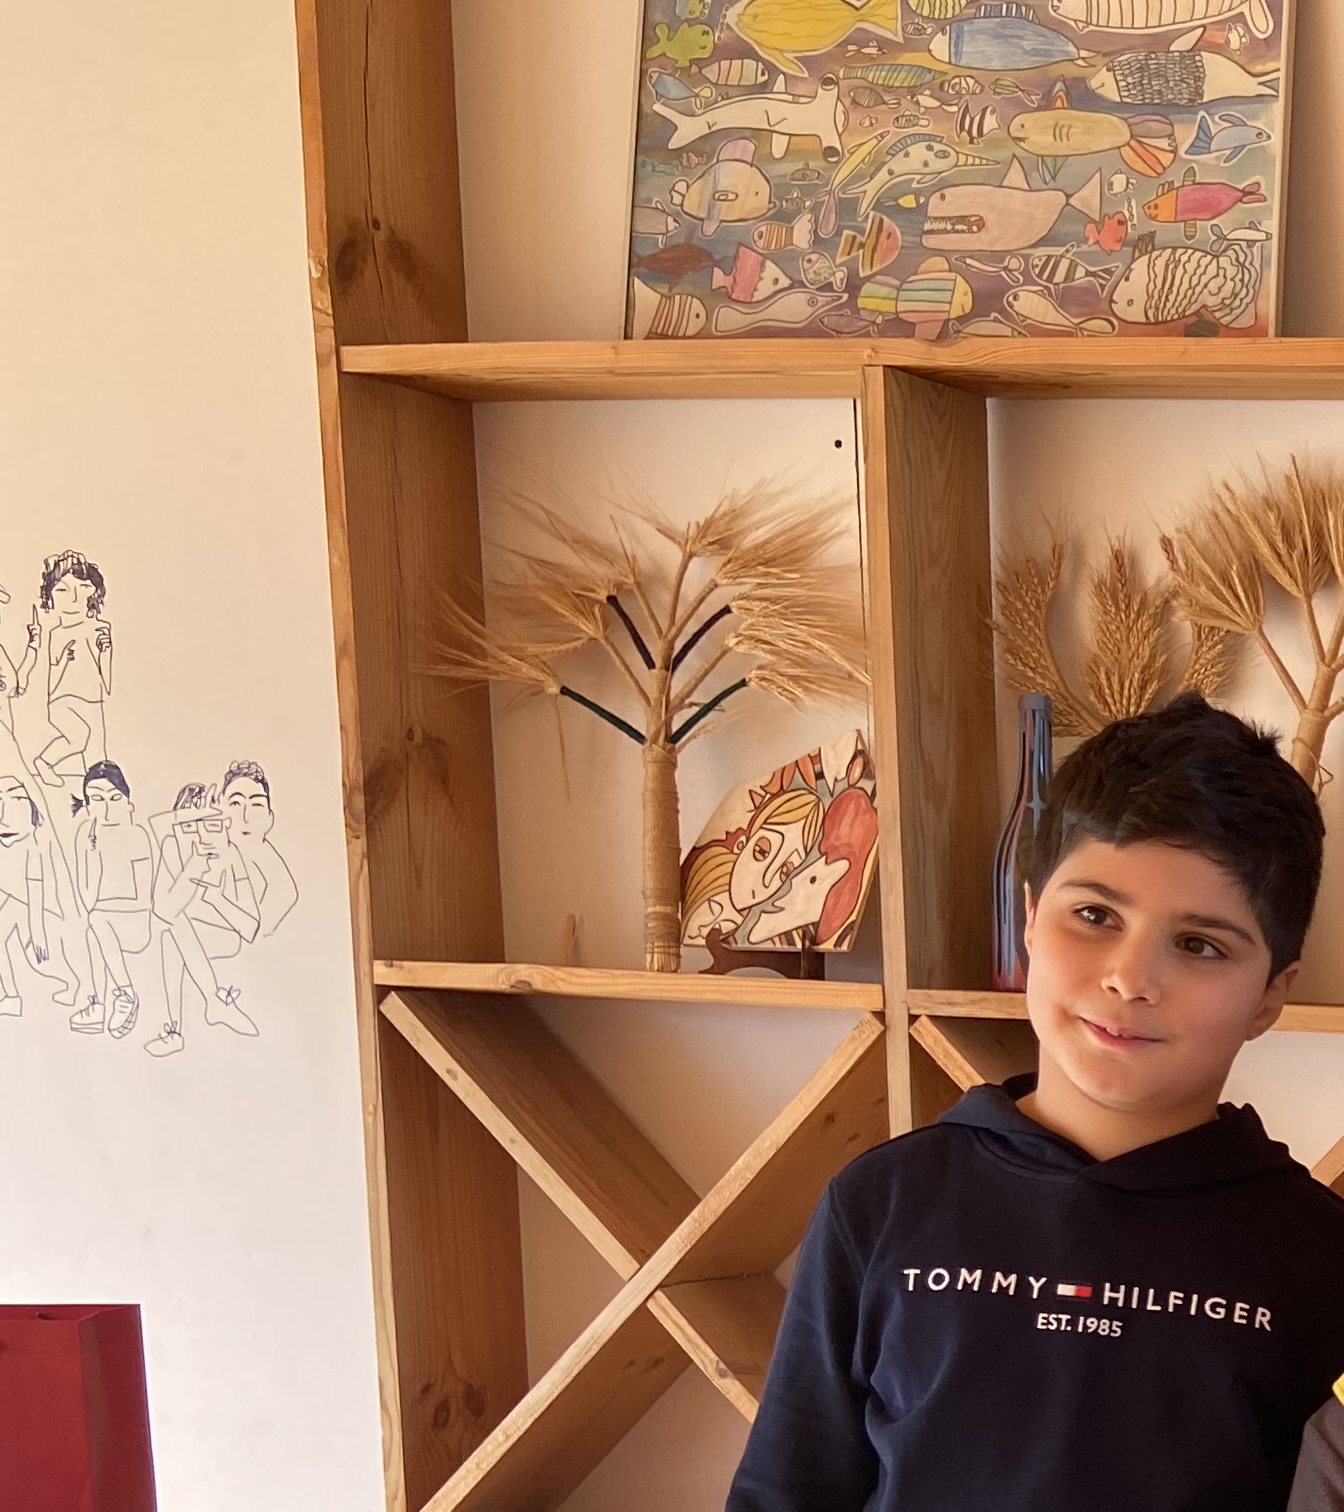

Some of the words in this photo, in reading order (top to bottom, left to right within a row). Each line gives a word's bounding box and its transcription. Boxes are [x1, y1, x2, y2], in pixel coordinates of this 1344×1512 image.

[902, 1267, 1048, 1299] TOMMY
[1103, 1282, 1273, 1331] HILFIGER
[1037, 1312, 1071, 1331] EST.
[1077, 1316, 1123, 1338] 1985
